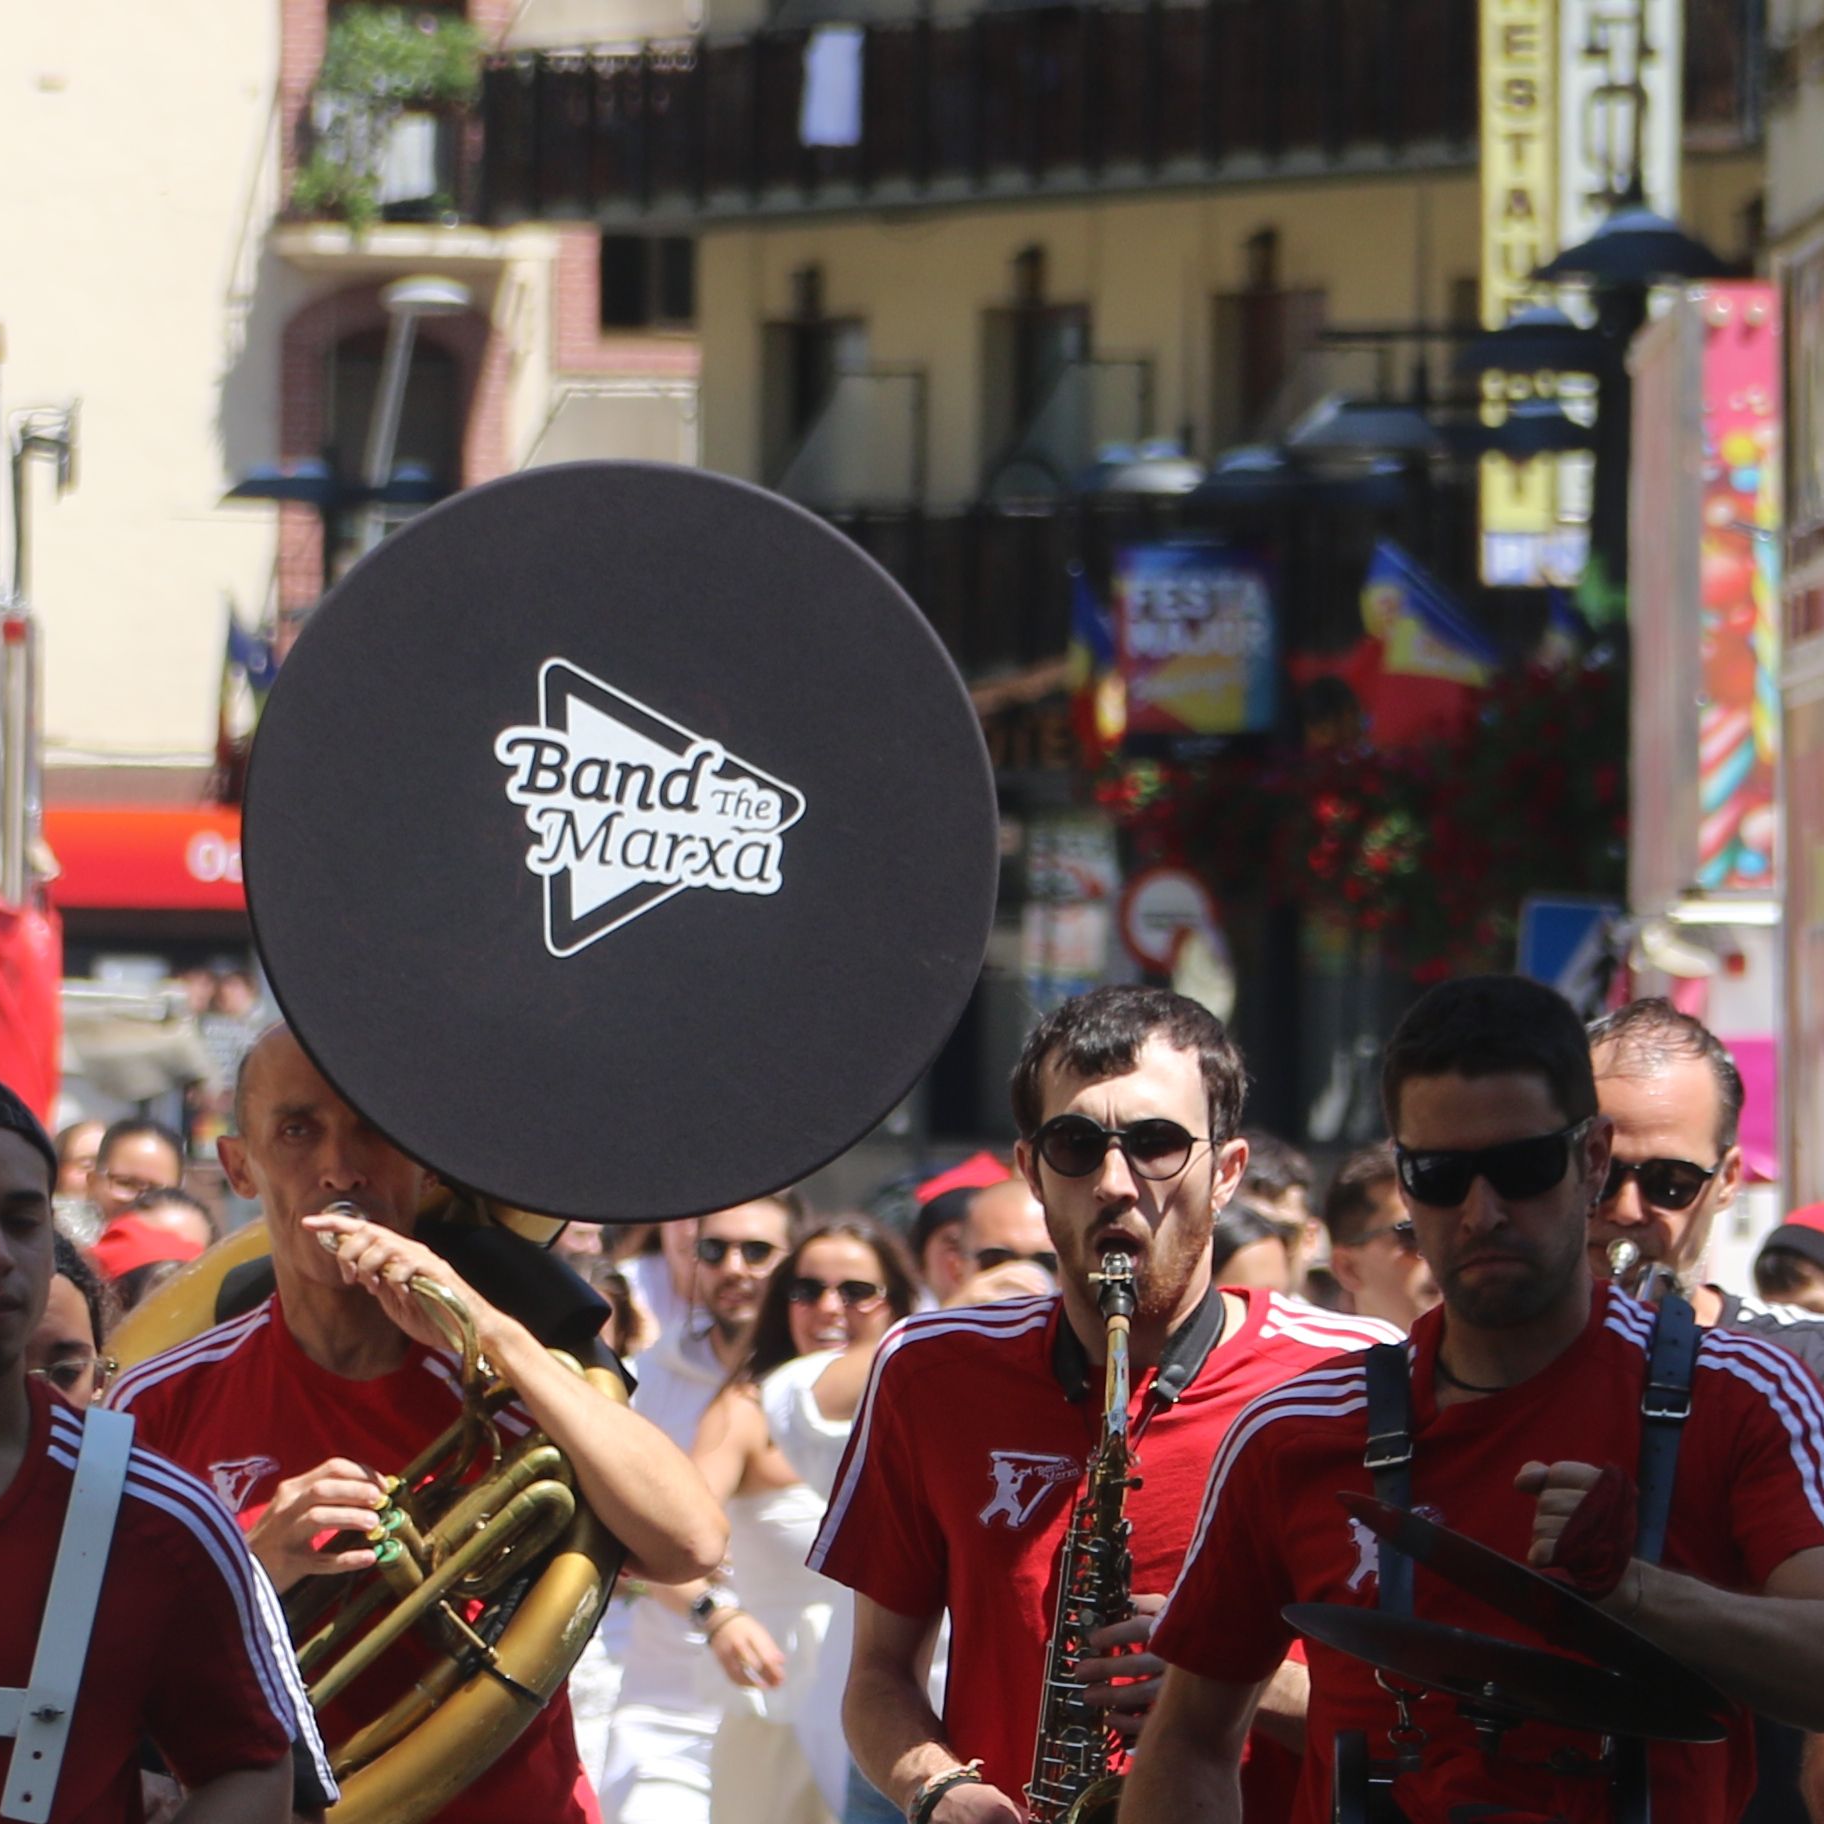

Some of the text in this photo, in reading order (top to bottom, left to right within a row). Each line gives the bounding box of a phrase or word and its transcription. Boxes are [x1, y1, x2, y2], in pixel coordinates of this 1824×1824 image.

[505, 736, 771, 821] Band The
[537, 806, 773, 883] Marxa
